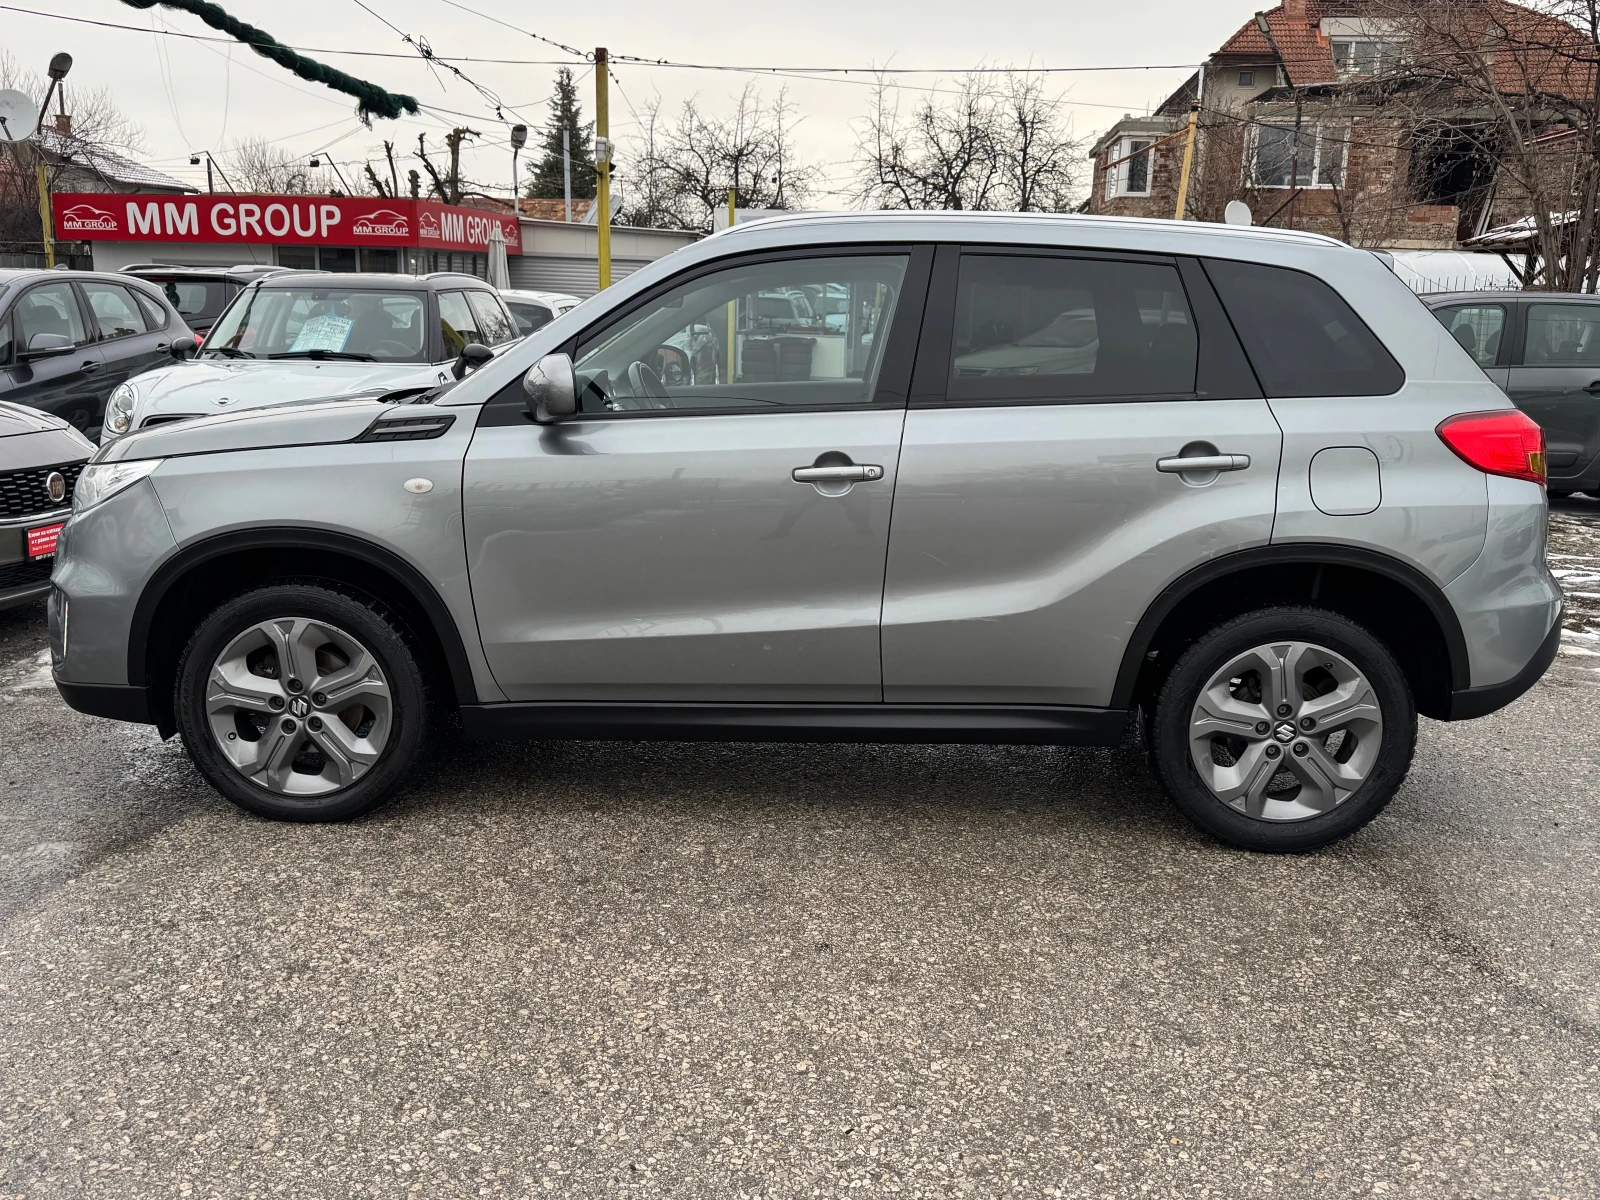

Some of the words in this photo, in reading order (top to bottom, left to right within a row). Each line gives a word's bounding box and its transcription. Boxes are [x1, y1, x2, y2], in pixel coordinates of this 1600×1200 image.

[63, 221, 82, 229] MM
[84, 221, 118, 229] GROUP
[126, 202, 199, 236] MM
[210, 202, 342, 238] GROUP
[441, 211, 465, 243] MM
[353, 226, 373, 234] MM
[374, 226, 409, 235] GROUP
